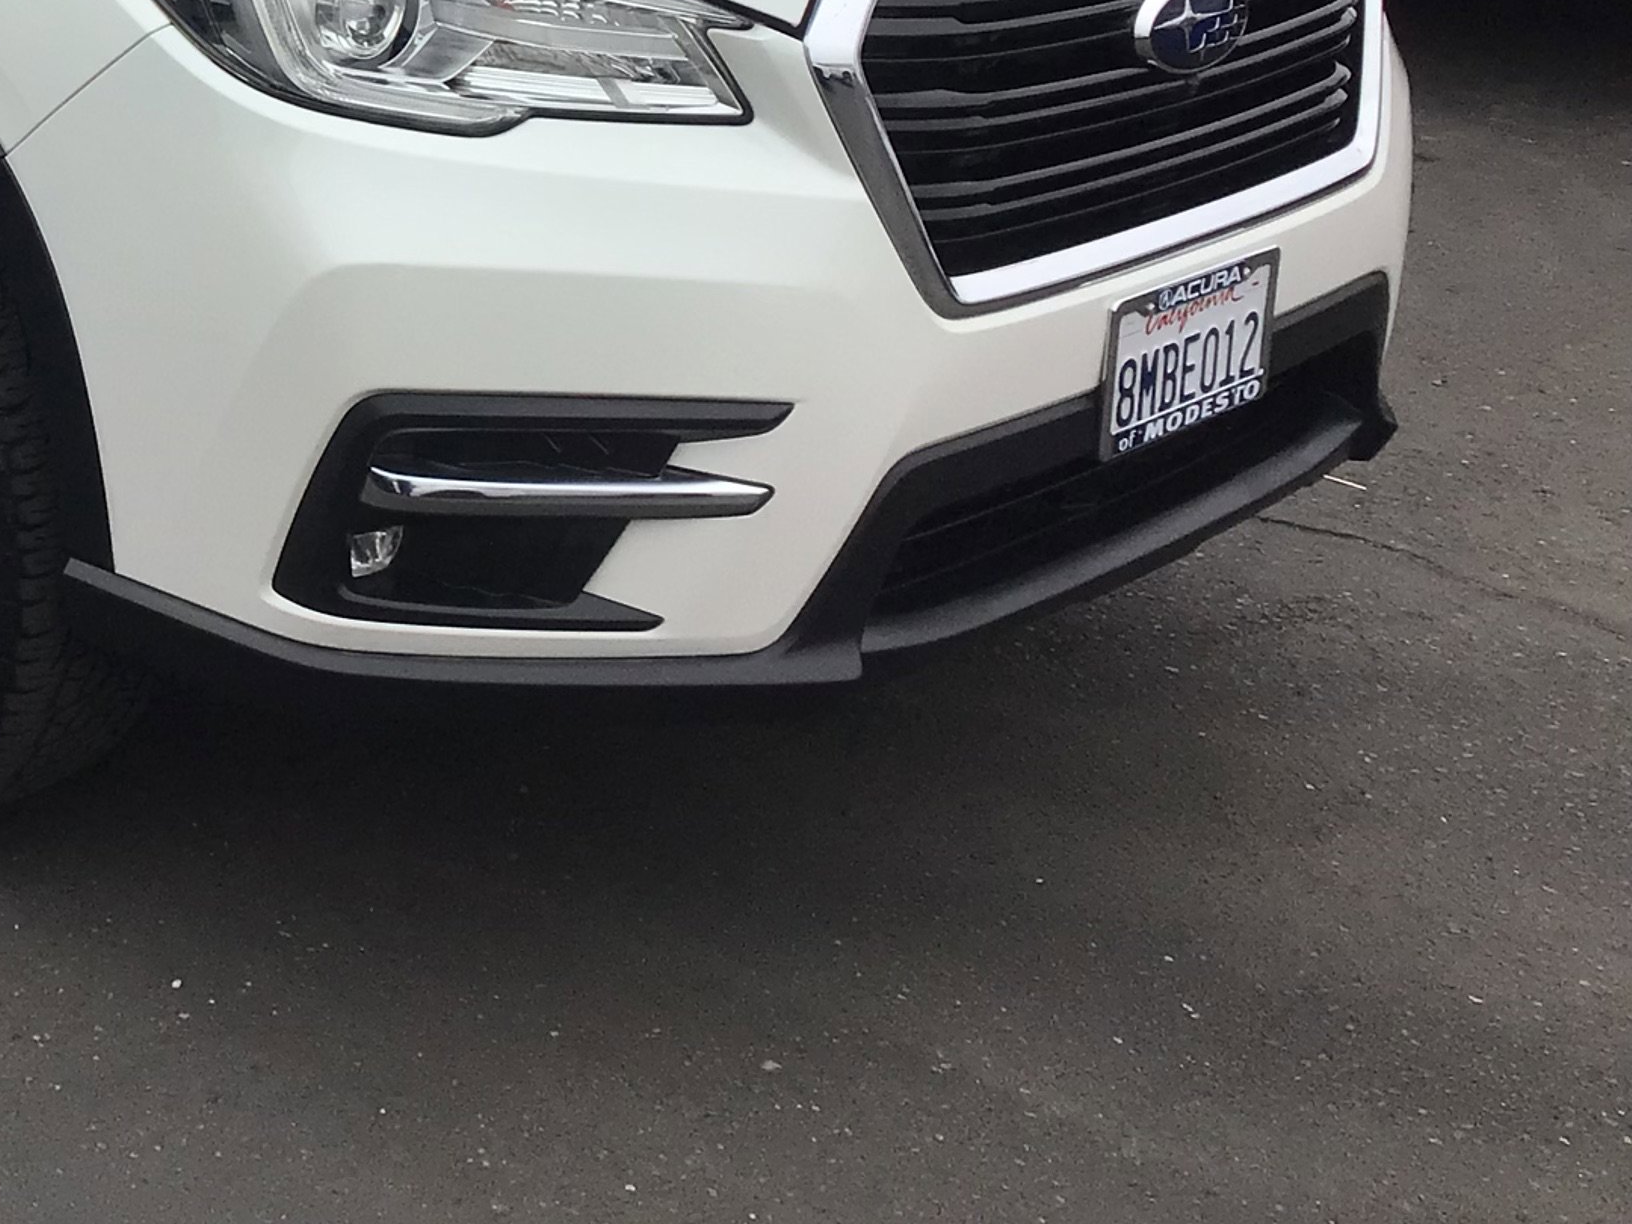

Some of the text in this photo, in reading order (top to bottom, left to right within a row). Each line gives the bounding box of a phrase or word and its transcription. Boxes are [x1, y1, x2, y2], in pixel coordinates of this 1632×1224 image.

[1172, 266, 1241, 303] ACURA
[1116, 310, 1260, 428] 8MBE012
[1118, 379, 1261, 452] of MODESTO
